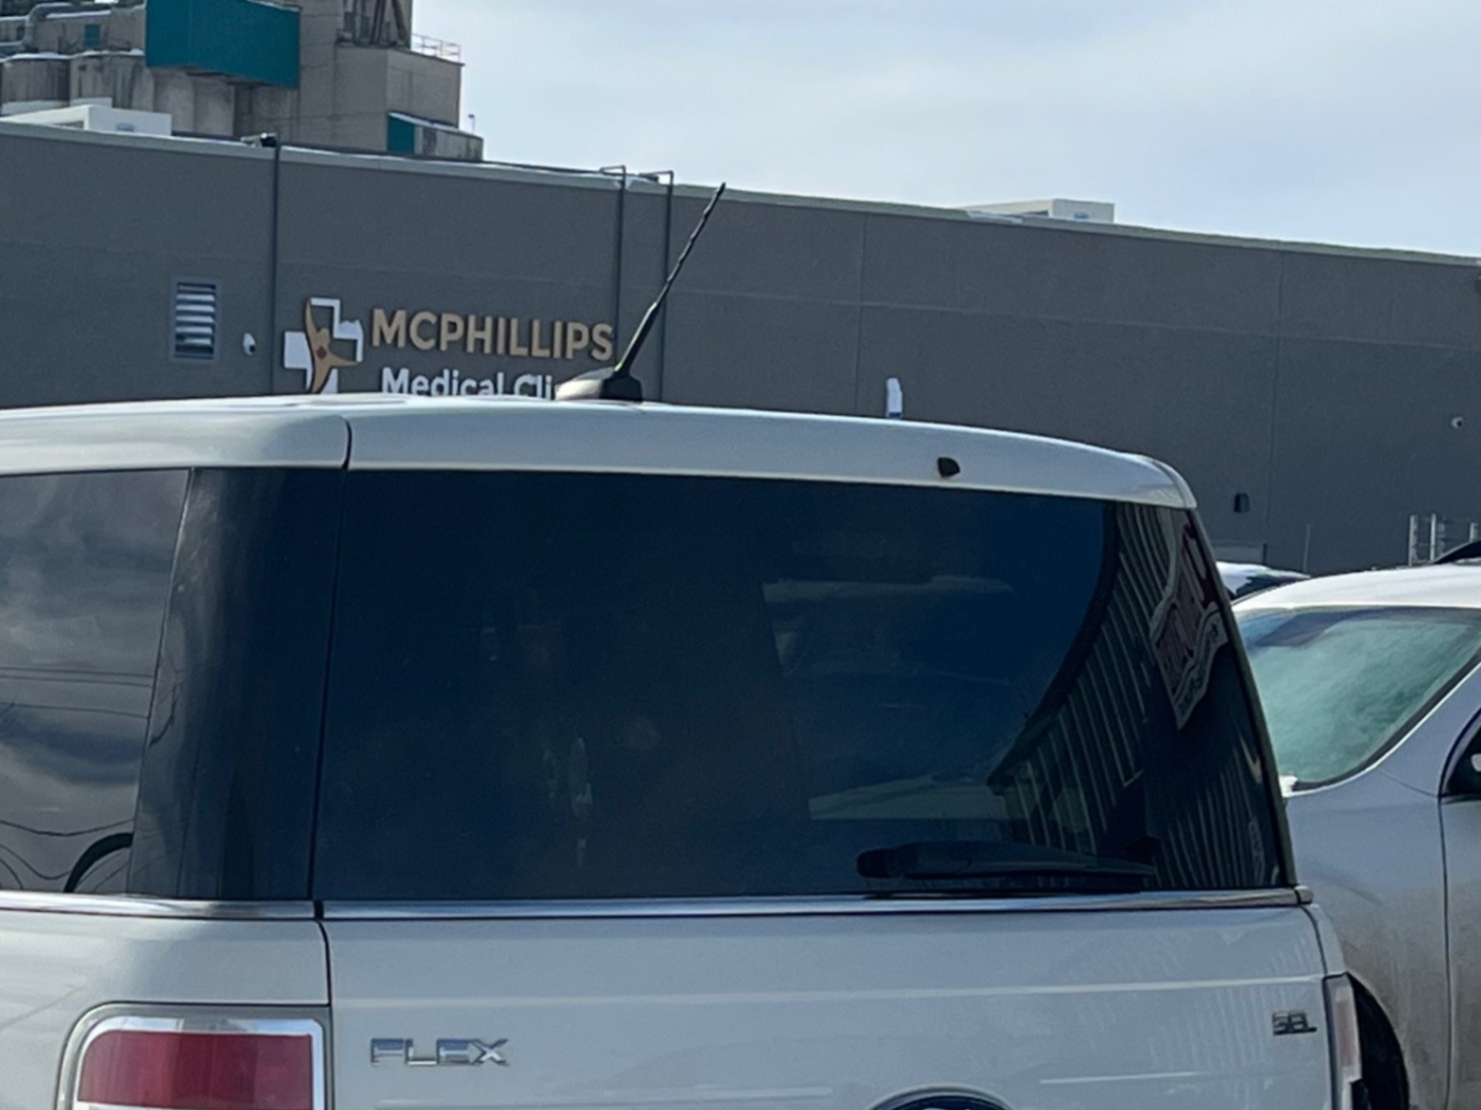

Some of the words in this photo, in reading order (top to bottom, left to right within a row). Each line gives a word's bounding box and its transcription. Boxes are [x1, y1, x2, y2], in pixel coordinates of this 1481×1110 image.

[371, 307, 614, 361] MCPHILLIPS
[381, 366, 506, 397] Medical
[513, 373, 554, 400] Cli
[370, 1037, 509, 1067] FLEX
